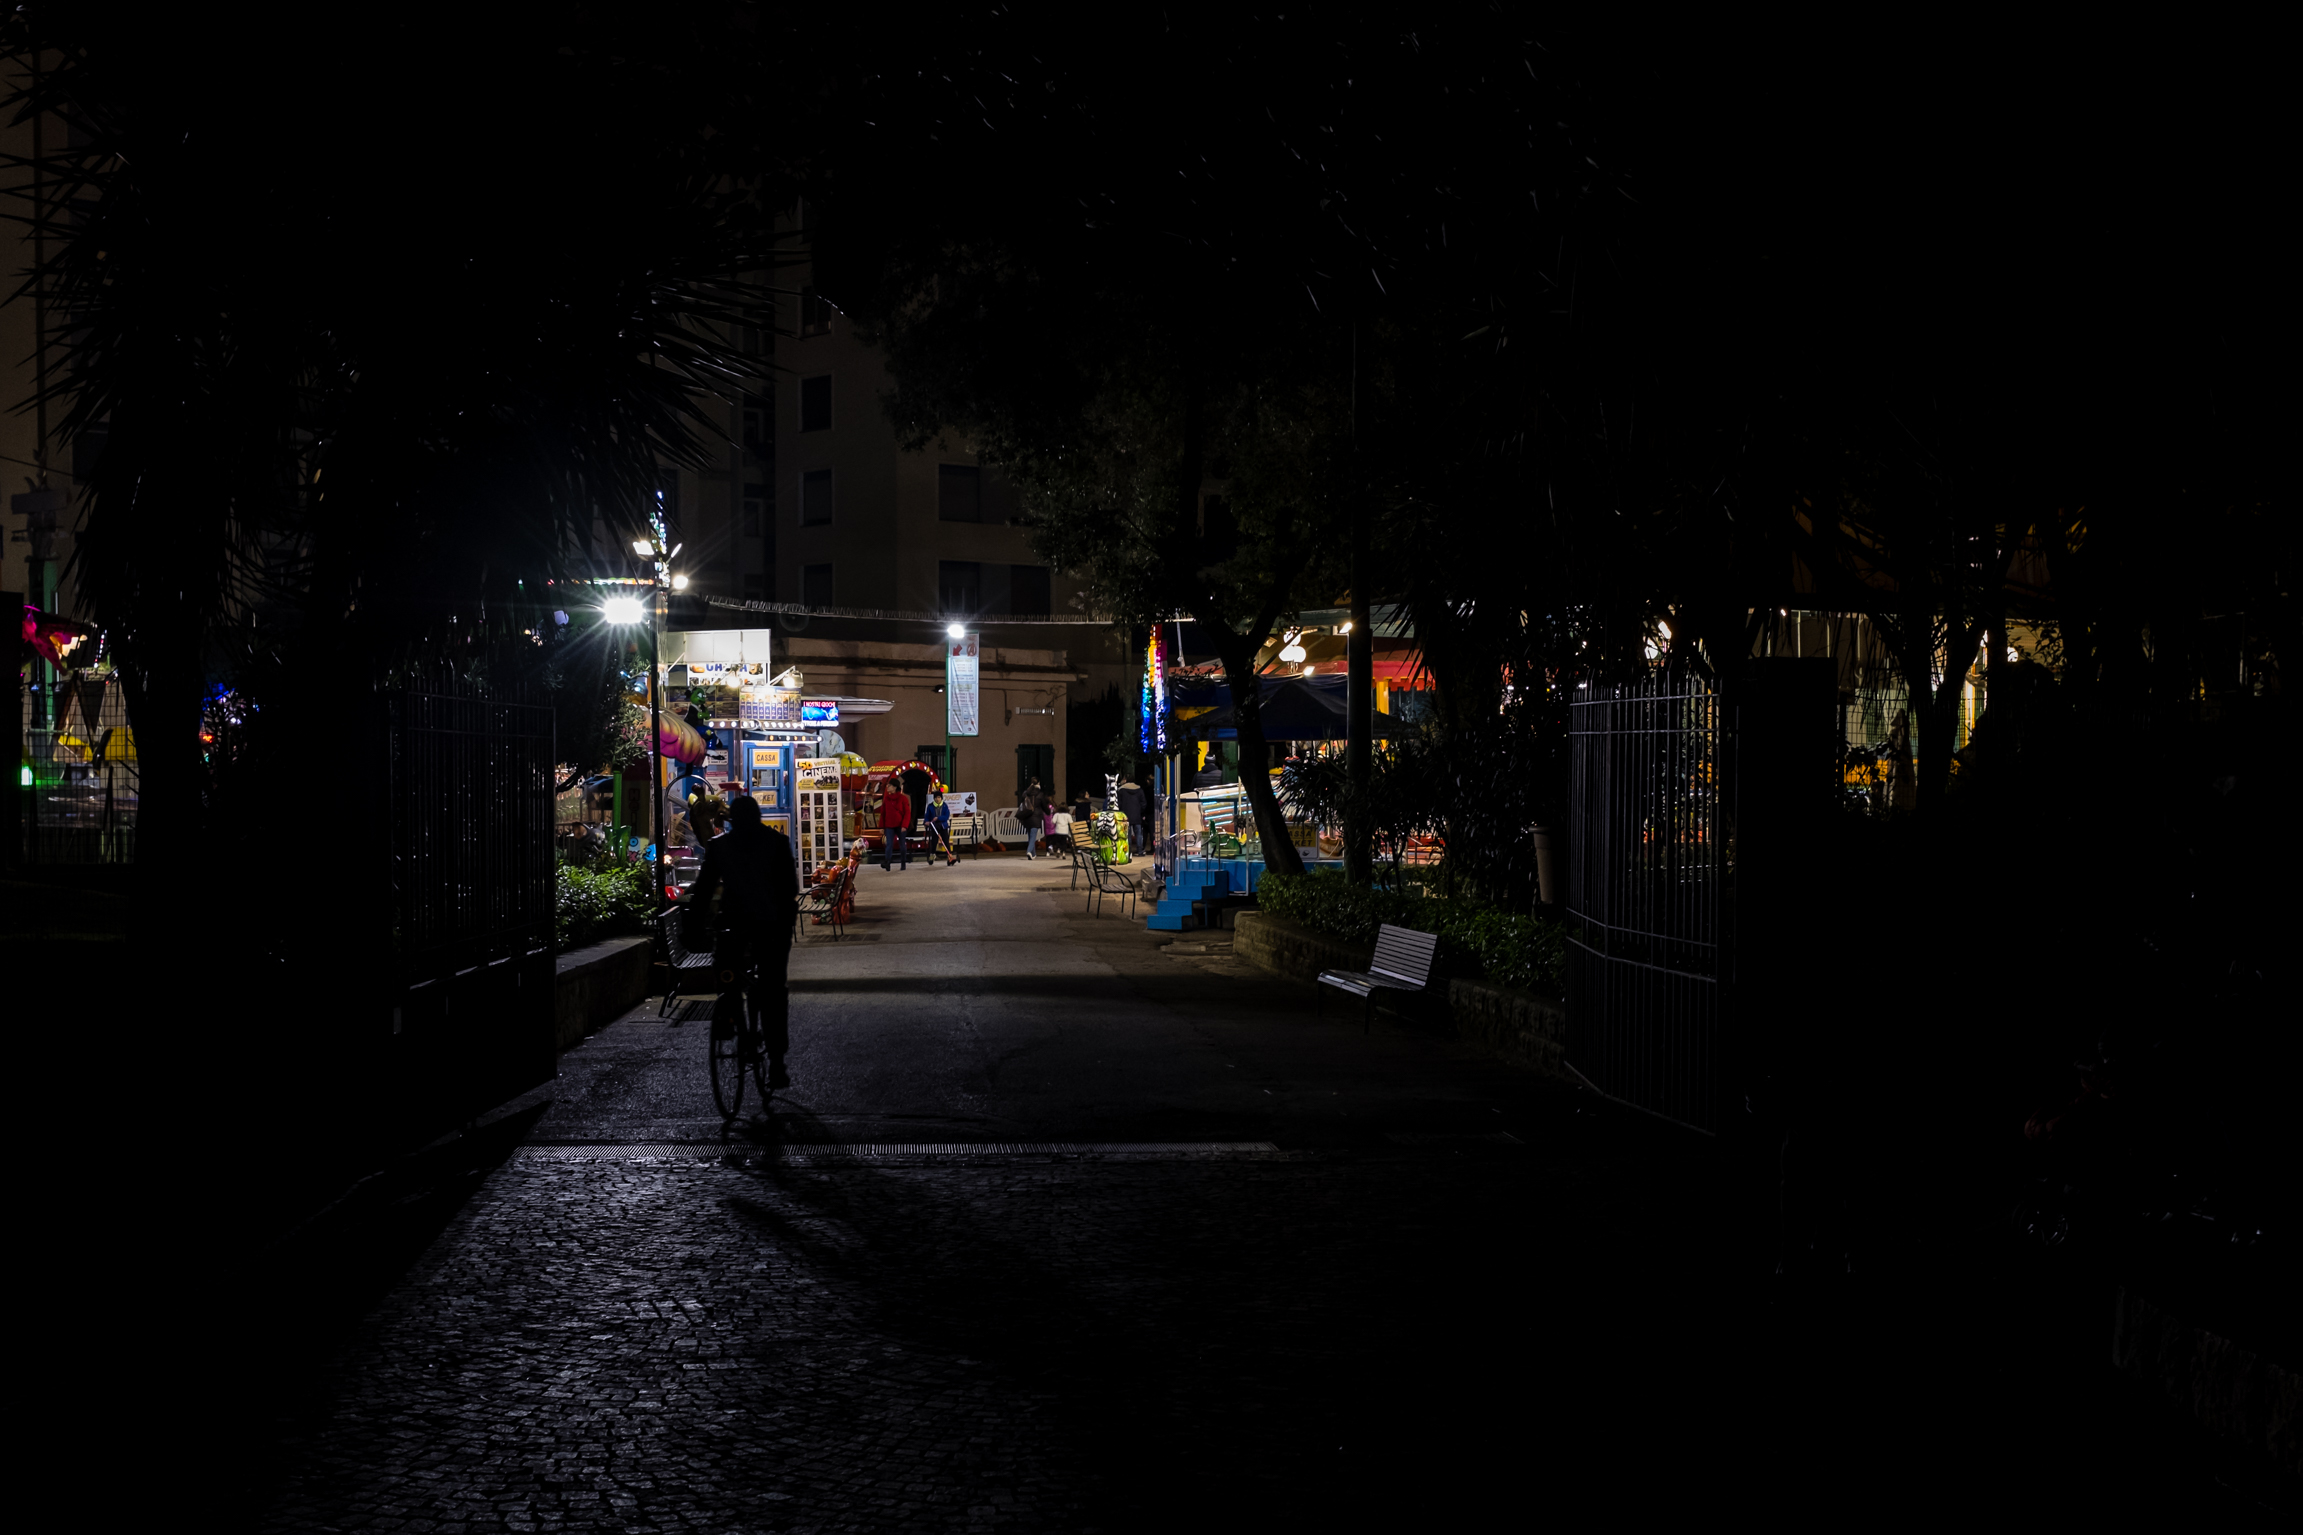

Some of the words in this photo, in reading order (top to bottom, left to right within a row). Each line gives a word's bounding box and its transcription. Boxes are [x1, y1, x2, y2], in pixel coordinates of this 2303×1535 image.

[756, 754, 776, 762] CASSA
[798, 761, 813, 770] 5D
[754, 794, 775, 802] TICKET
[1293, 839, 1313, 847] KET
